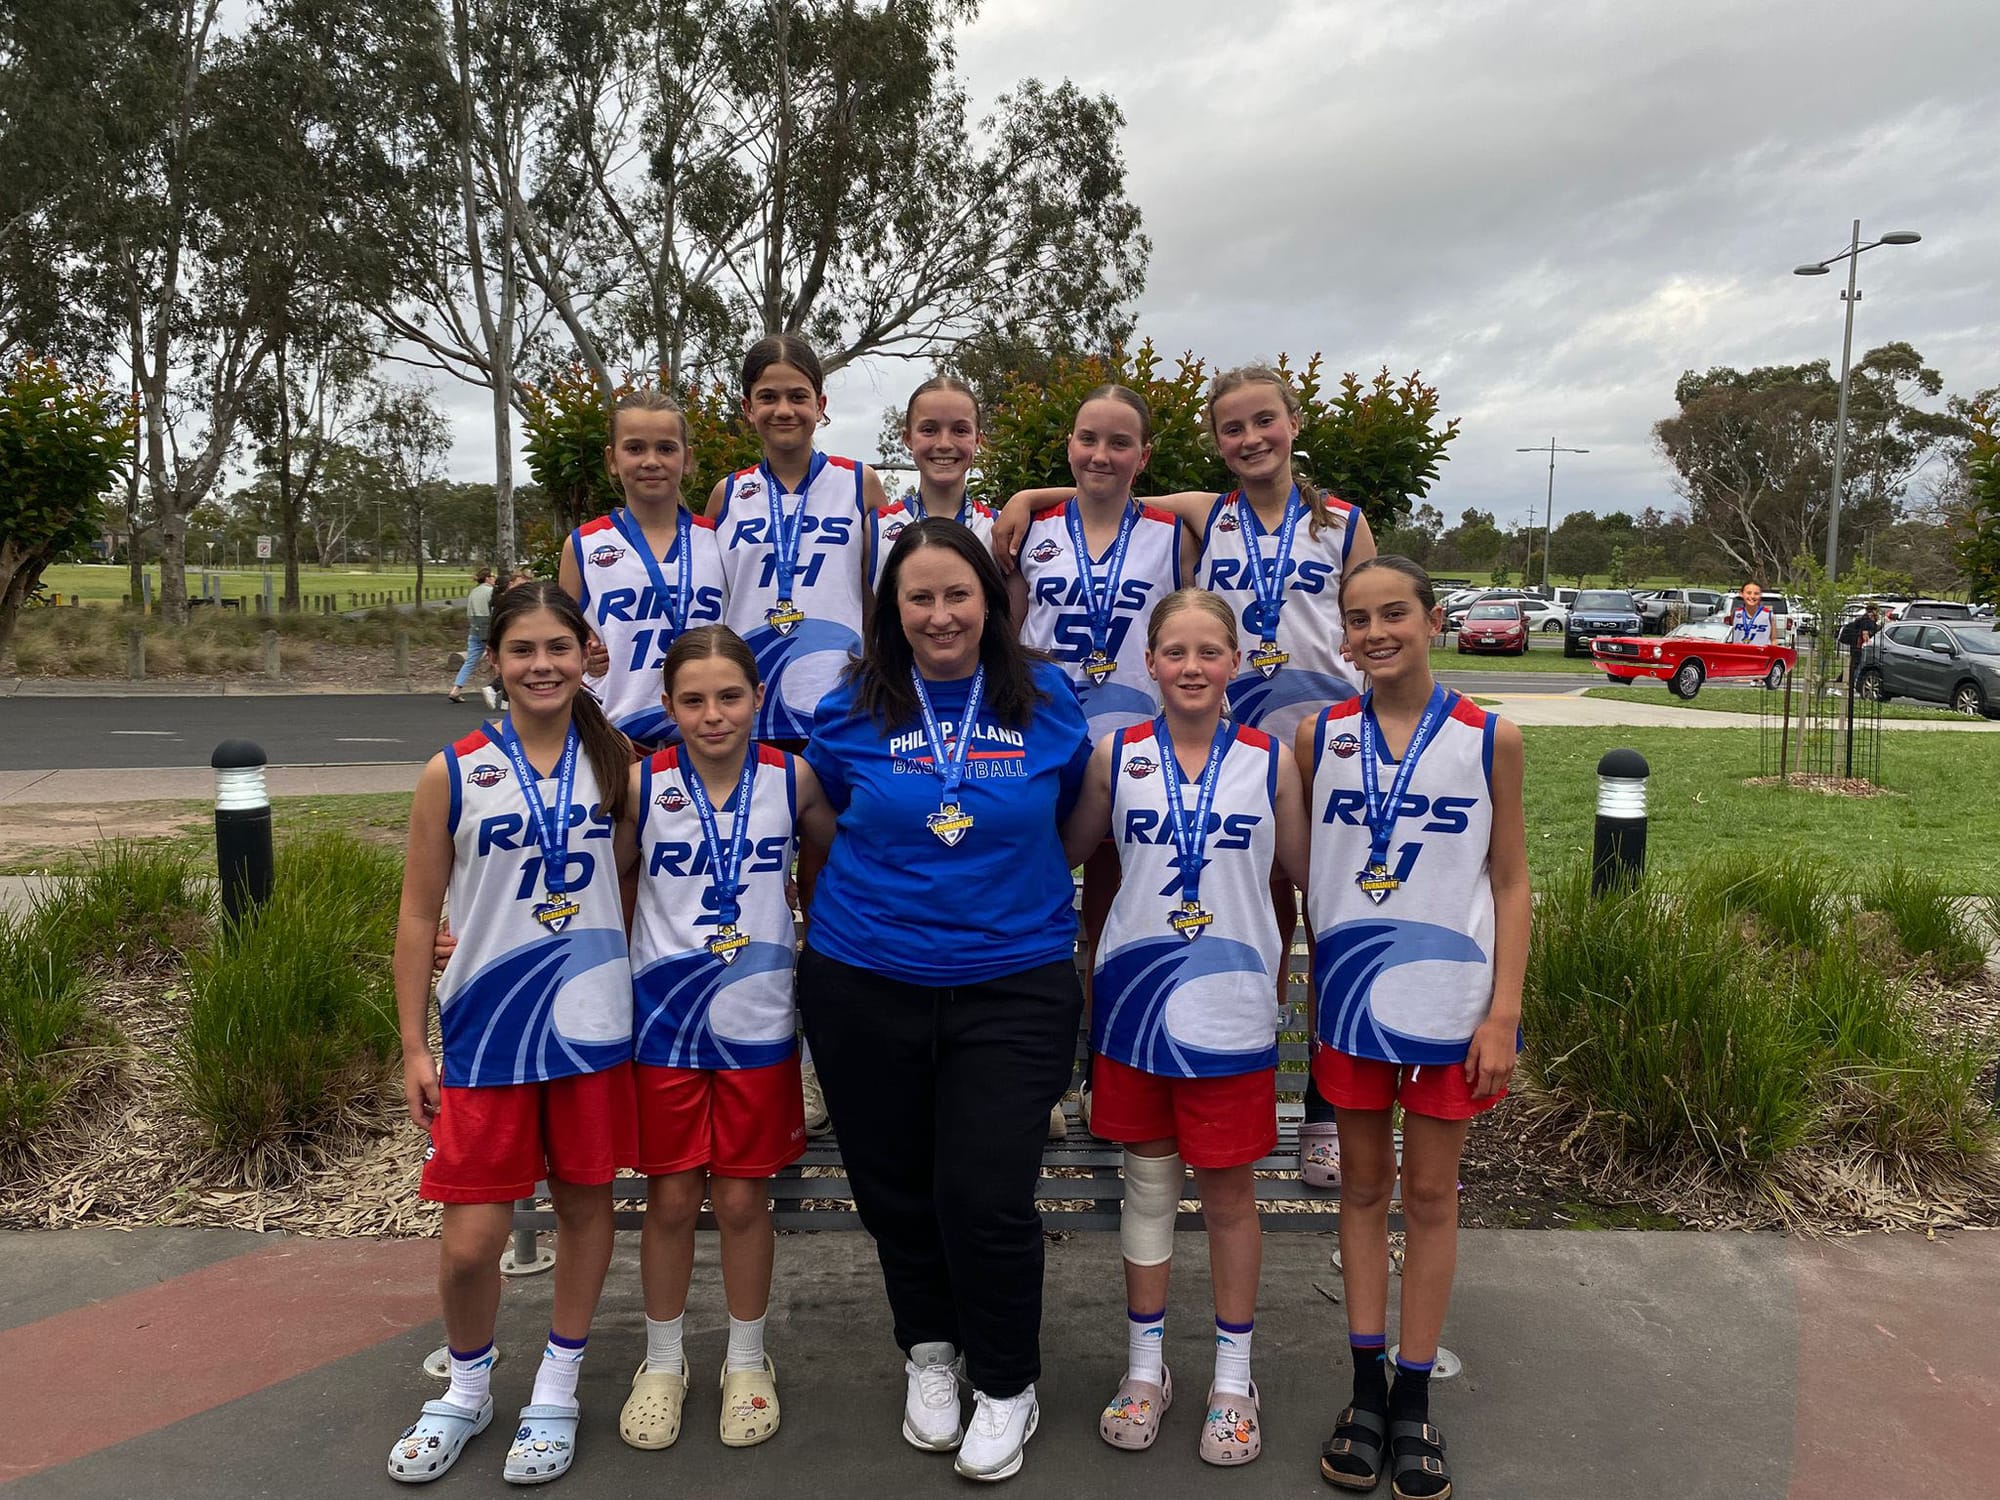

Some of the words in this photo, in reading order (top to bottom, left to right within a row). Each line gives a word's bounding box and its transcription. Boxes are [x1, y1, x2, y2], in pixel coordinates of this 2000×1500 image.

[882, 525, 904, 539] RIP
[588, 549, 625, 564] RIPS
[1735, 623, 1768, 632] RPS
[1048, 614, 1134, 663] 51
[890, 721, 954, 755] PHILP
[959, 721, 1024, 748] LAND
[1328, 740, 1361, 752] RIPS
[1408, 728, 1427, 759] balance
[467, 768, 508, 783] RIPS
[515, 756, 531, 787] balance
[892, 758, 1028, 779] BASTBALL
[1123, 761, 1159, 773] RIPS
[655, 794, 691, 806] RIPS
[1124, 809, 1263, 850] RIPS
[650, 836, 790, 877] RIPS
